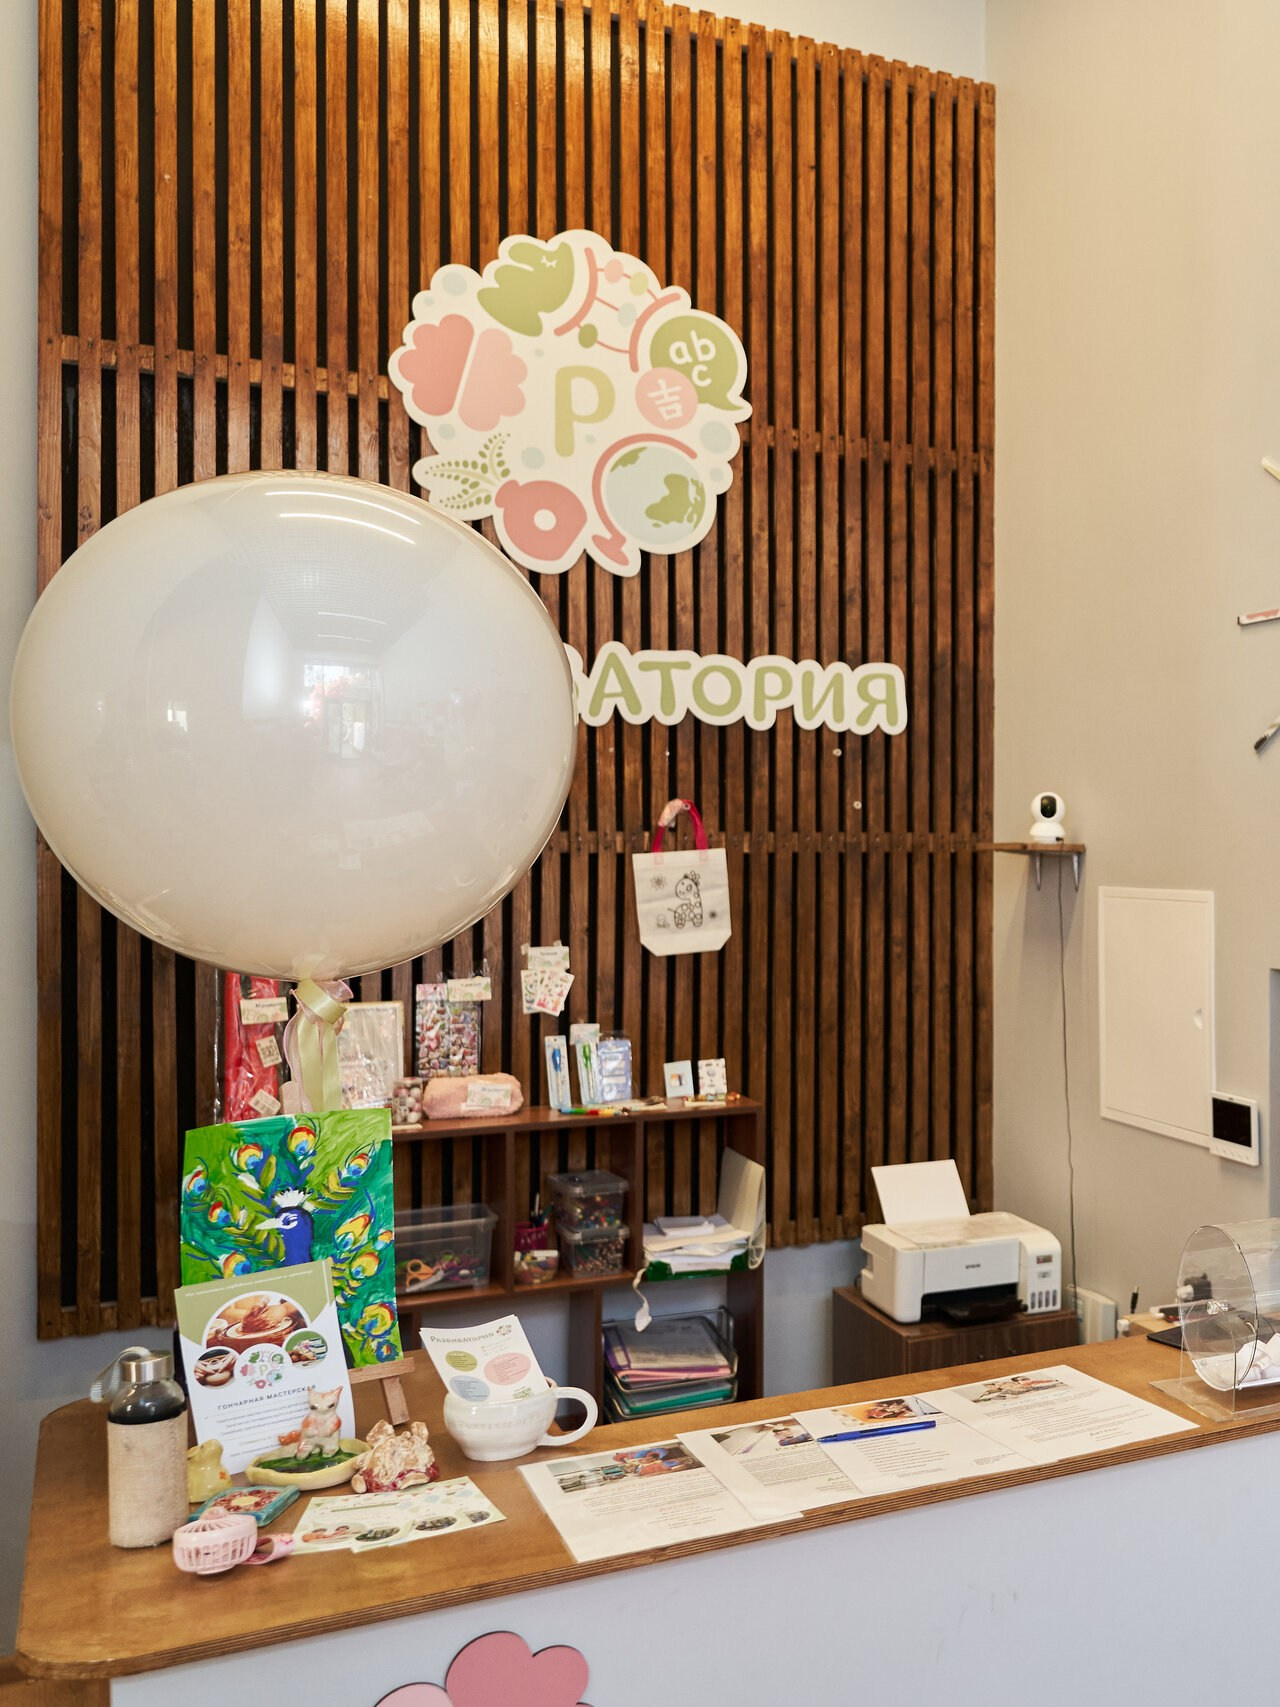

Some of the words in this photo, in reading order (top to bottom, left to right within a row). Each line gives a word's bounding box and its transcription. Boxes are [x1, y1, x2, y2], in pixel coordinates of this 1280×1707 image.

[647, 381, 684, 422] 吉
[573, 651, 899, 728] АТОРИЯ
[217, 1396, 264, 1411] ГОНЧАРНАЯ
